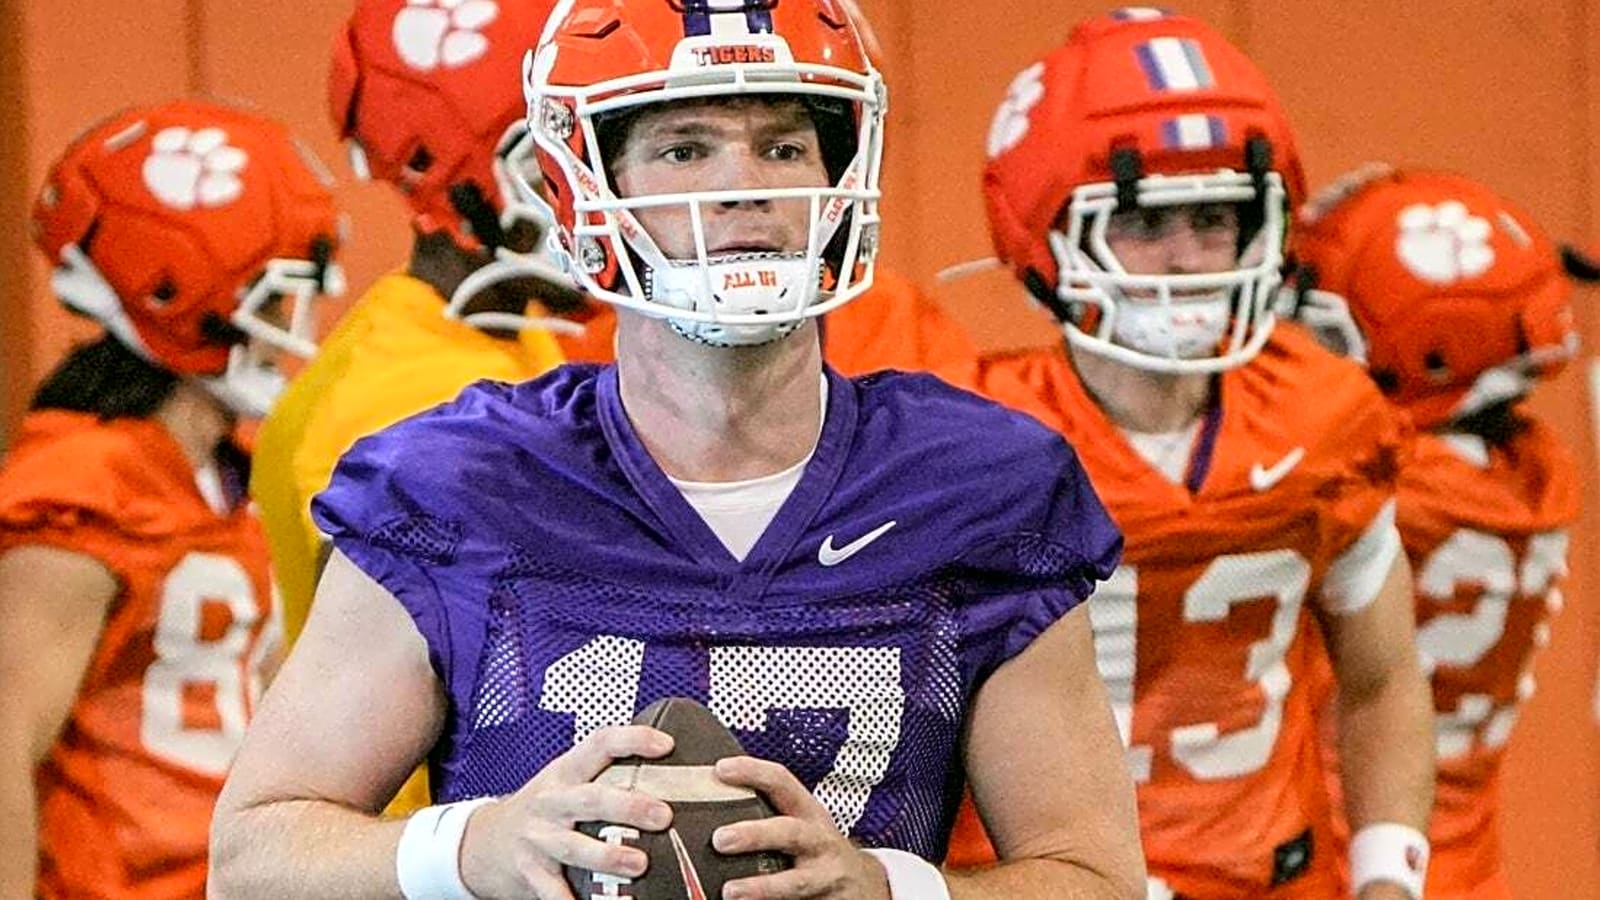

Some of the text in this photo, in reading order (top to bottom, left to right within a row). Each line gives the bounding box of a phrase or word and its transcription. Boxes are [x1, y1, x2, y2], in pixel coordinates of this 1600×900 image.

[691, 45, 775, 66] TIGERS
[723, 269, 777, 290] ALL IN
[1087, 548, 1312, 782] 13
[539, 634, 905, 837] 17
